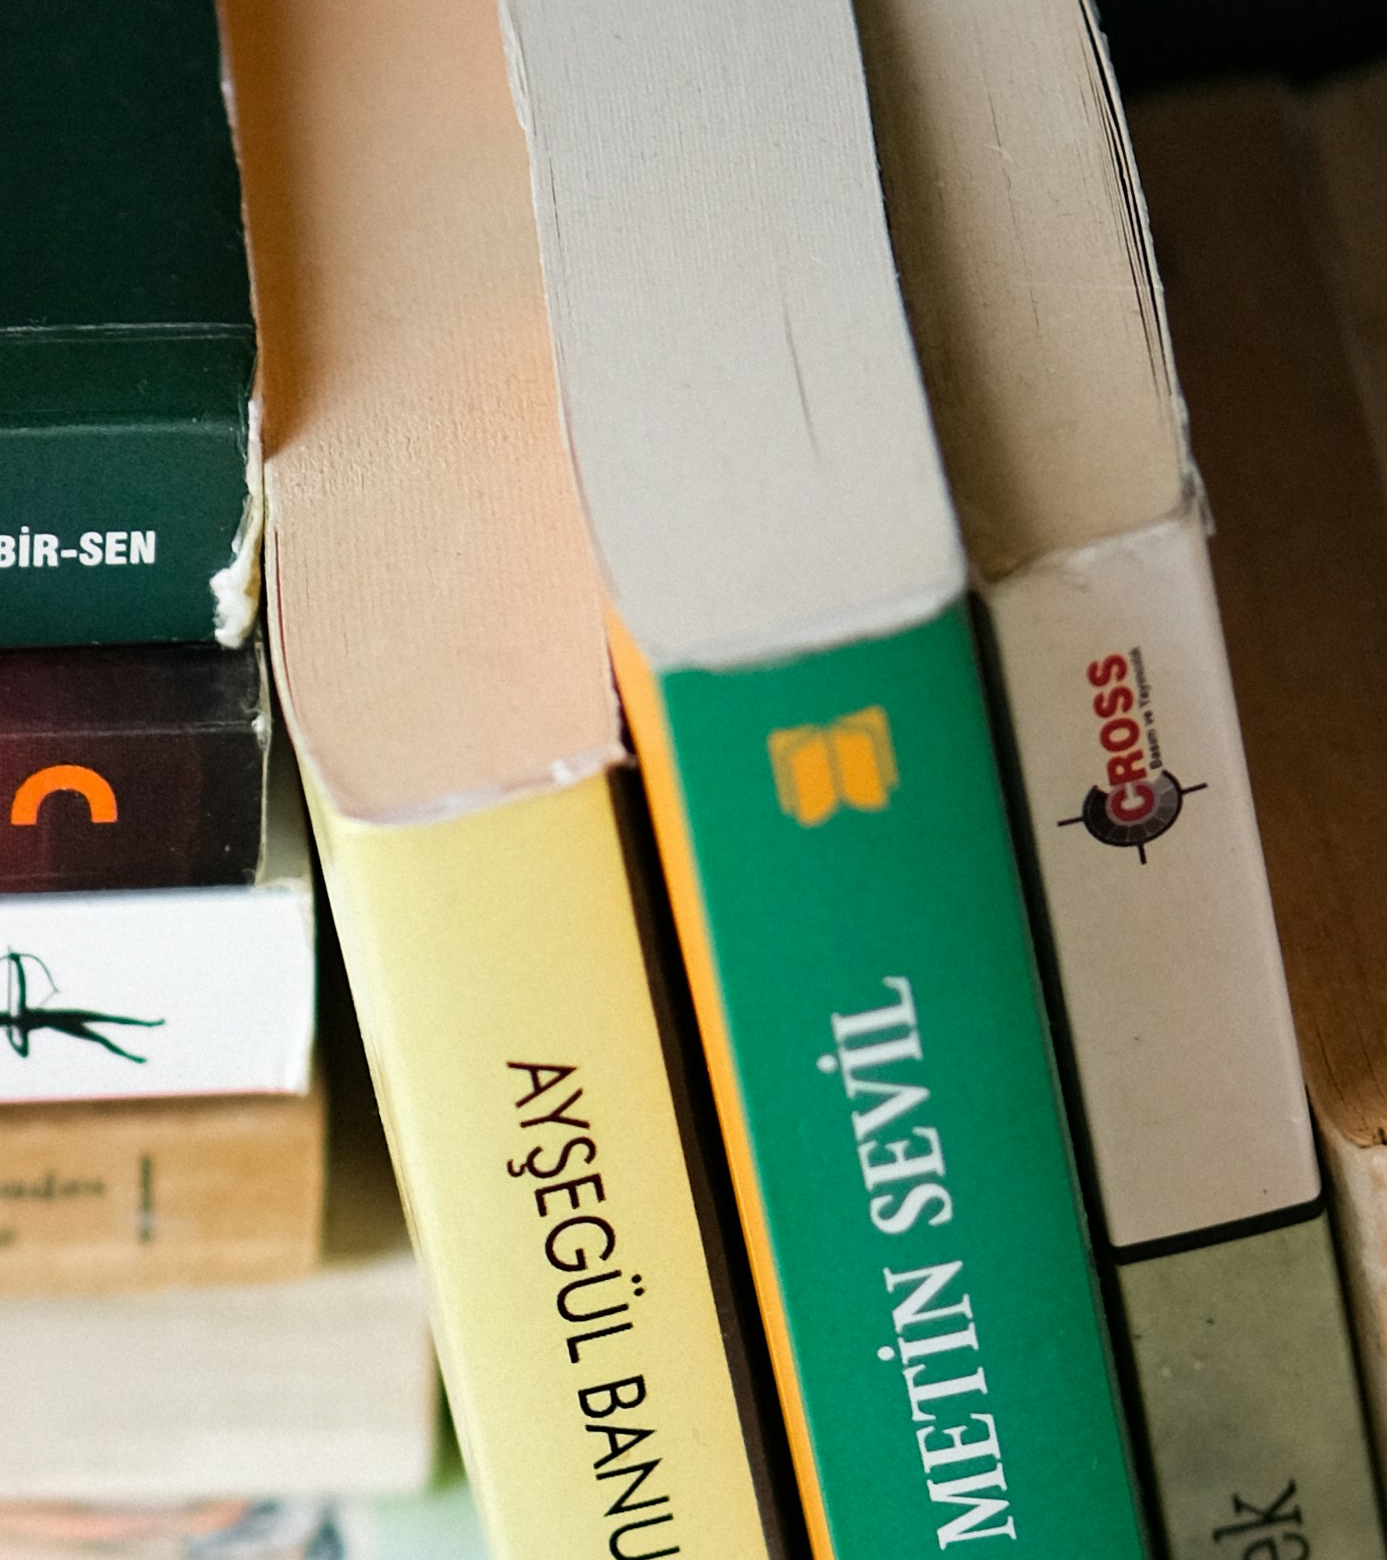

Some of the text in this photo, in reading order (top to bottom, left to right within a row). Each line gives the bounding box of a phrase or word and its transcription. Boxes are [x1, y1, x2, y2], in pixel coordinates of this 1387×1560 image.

[1086, 653, 1156, 823] CROSS
[505, 1058, 650, 1365] AYŞEGÜL
[815, 975, 1018, 1552] METİN SEVİL
